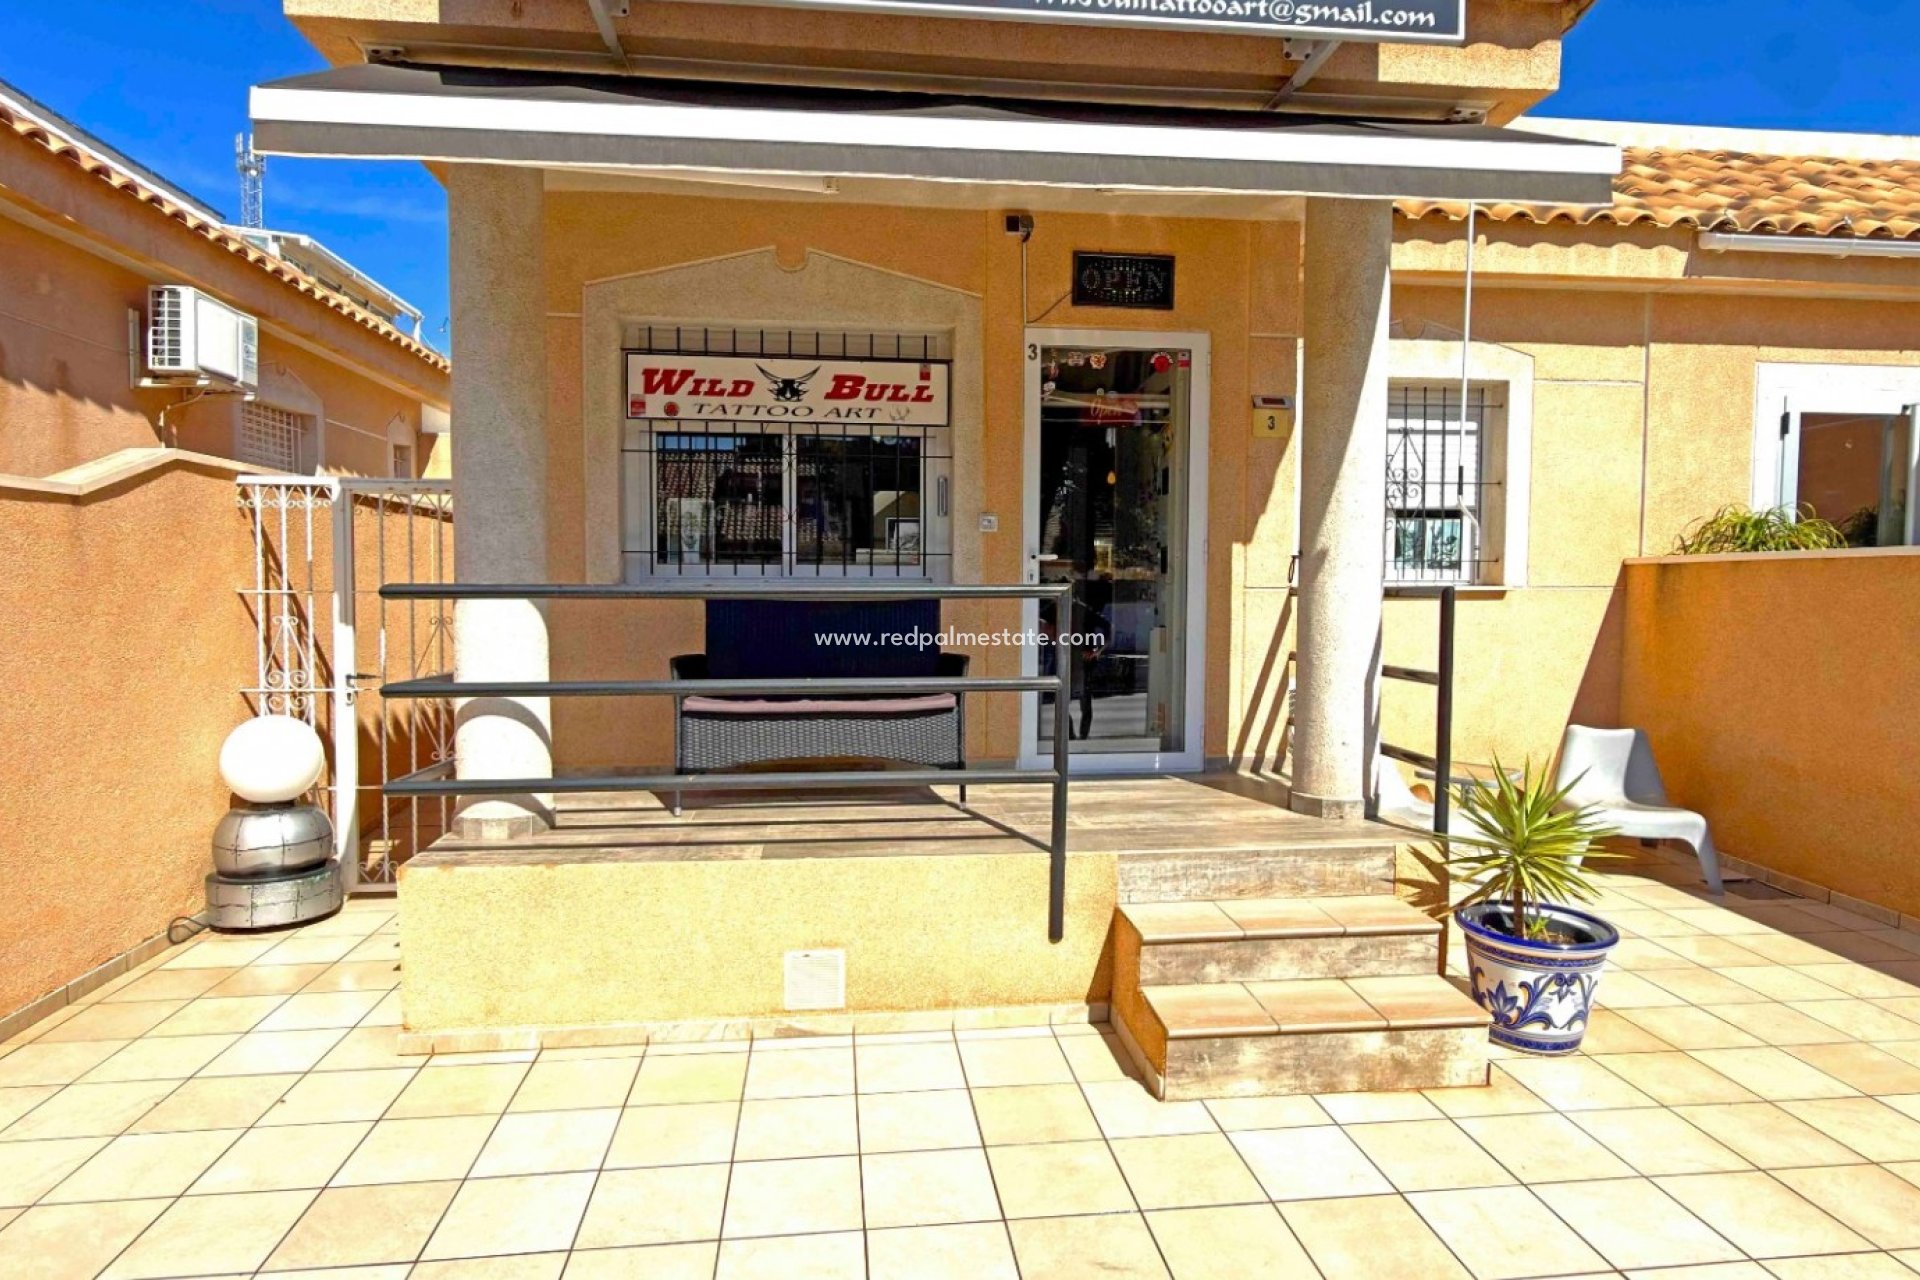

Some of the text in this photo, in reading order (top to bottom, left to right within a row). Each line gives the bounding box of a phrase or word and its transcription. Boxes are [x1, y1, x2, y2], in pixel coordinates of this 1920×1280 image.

[1082, 267, 1167, 293] OPEN
[1028, 344, 1038, 361] 3
[693, 402, 882, 418] TATTOO ART
[1267, 415, 1276, 431] 3
